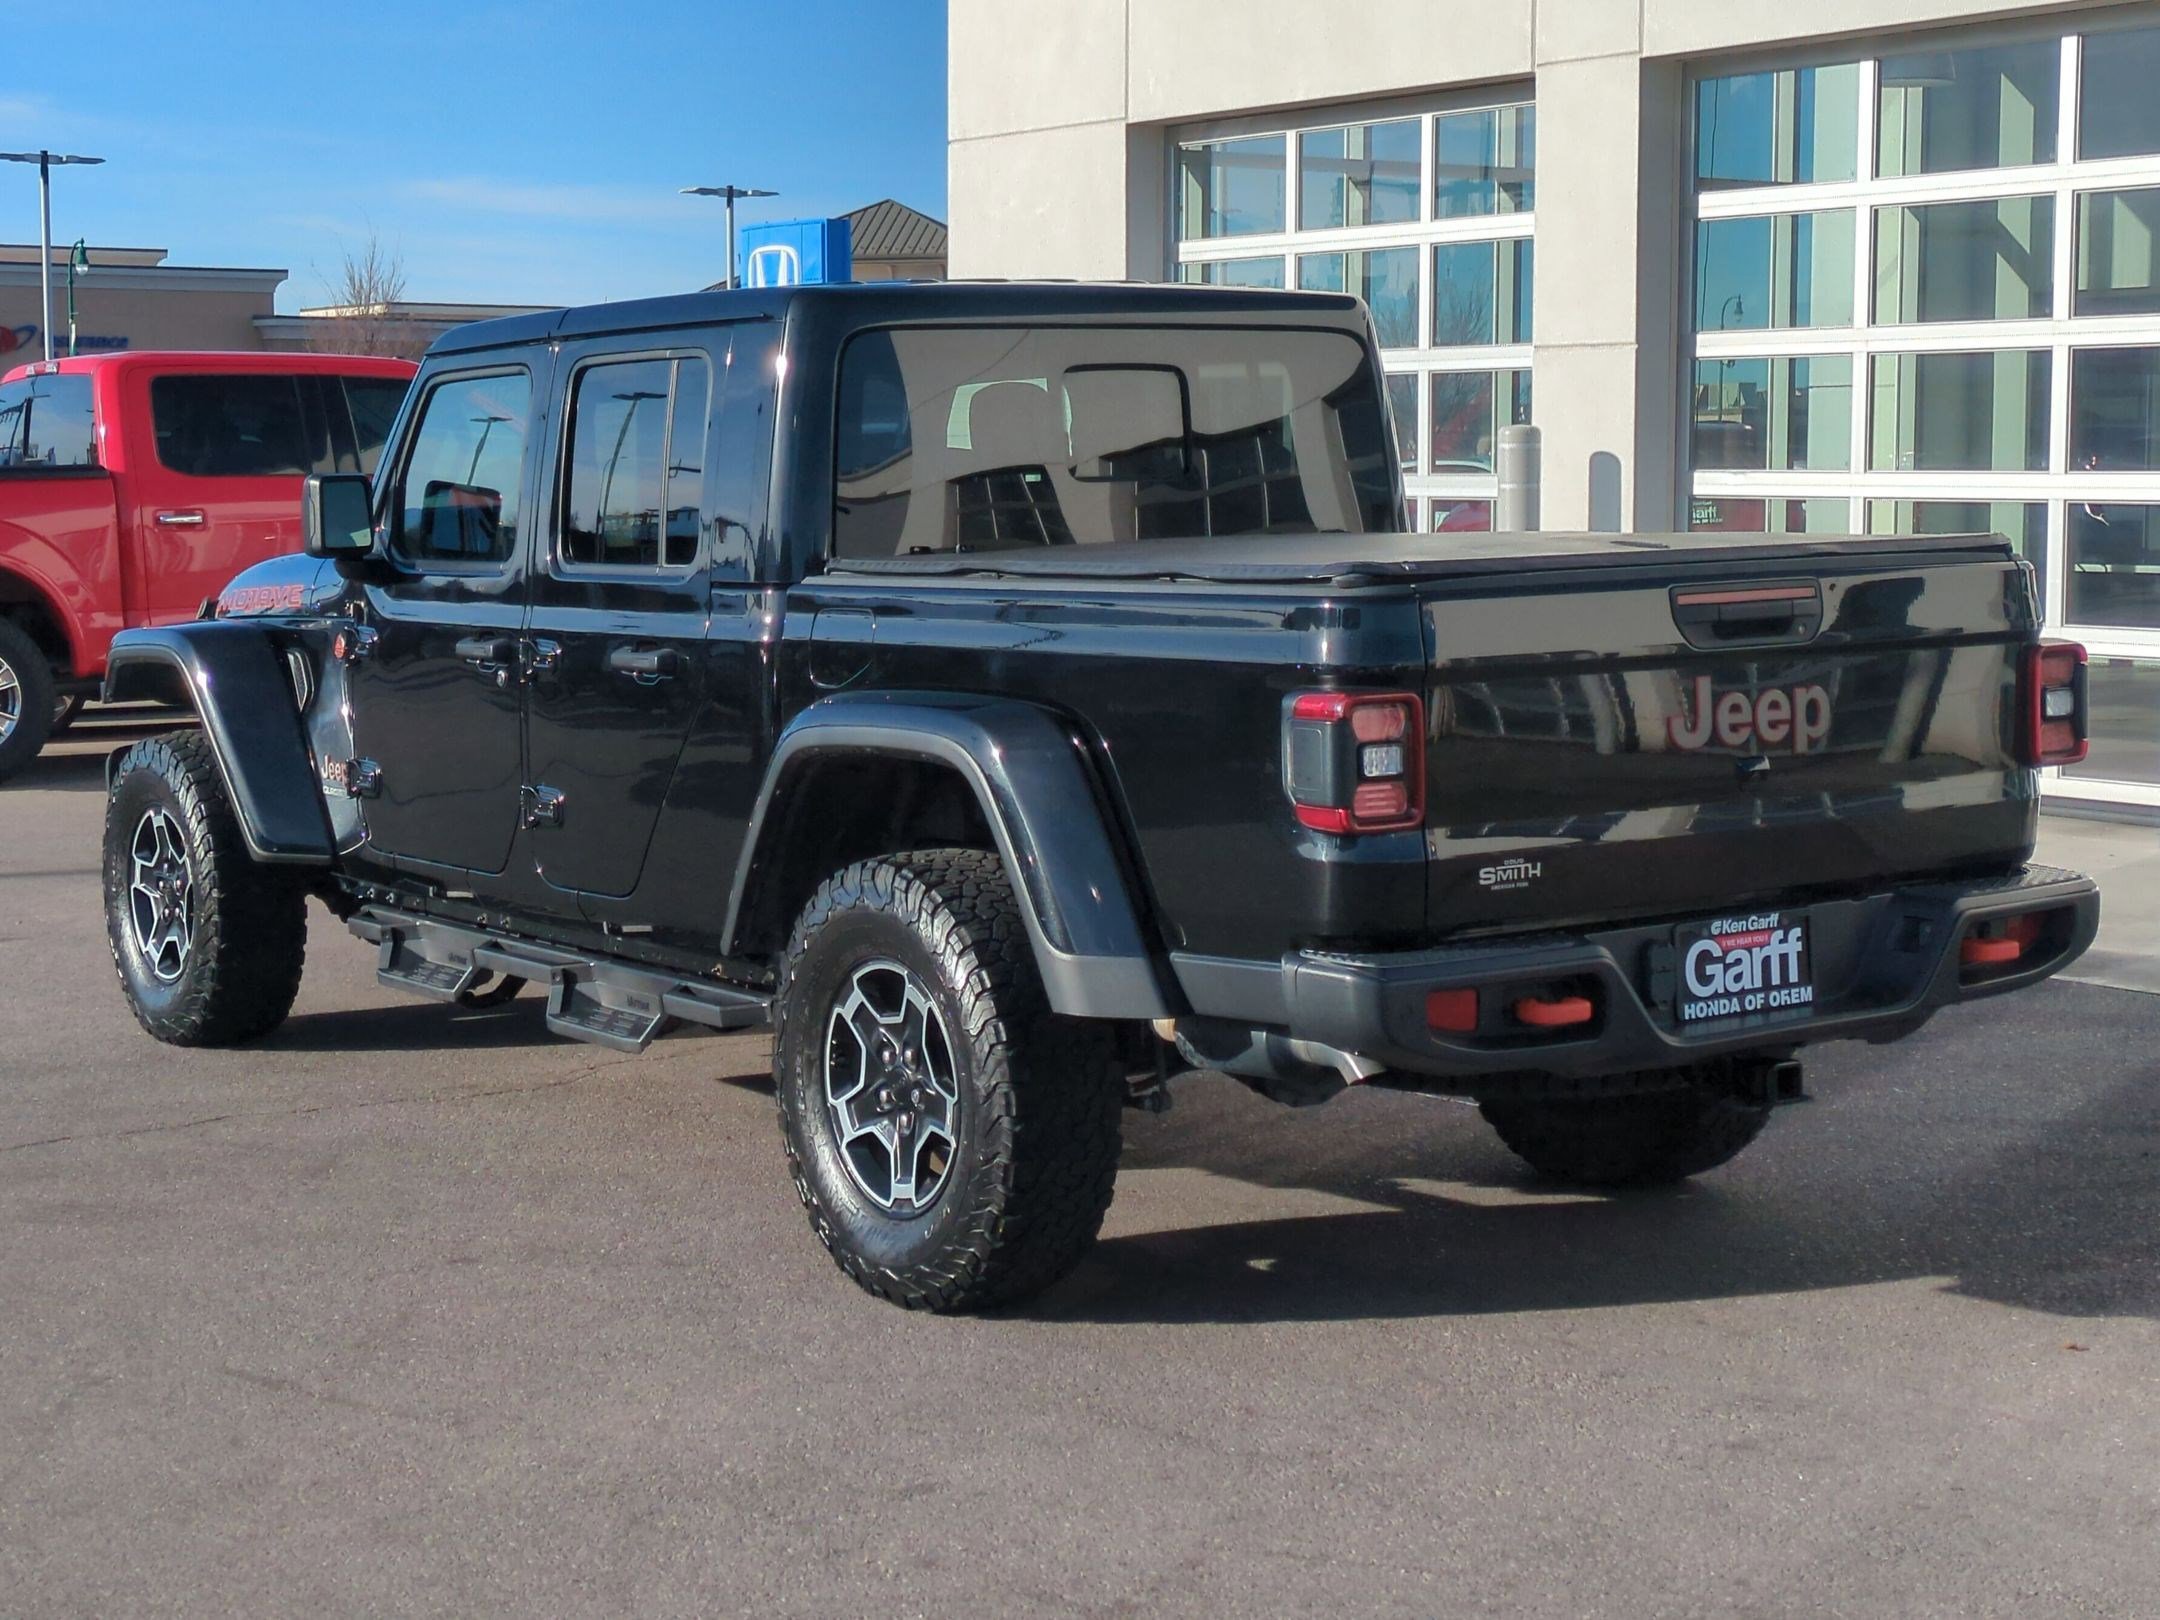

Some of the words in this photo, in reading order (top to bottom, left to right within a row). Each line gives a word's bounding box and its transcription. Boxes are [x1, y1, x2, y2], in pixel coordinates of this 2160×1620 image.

[217, 584, 304, 613] MOJAVE
[1667, 675, 1831, 754] Jeep
[1479, 862, 1541, 885] SMITH
[1722, 919, 1746, 934] Ken
[1748, 913, 1779, 930] Garff
[1685, 927, 1802, 997] Garff
[1684, 998, 1740, 1019] HONDA
[1744, 993, 1765, 1012] OF
[1769, 986, 1812, 1007] OREM
